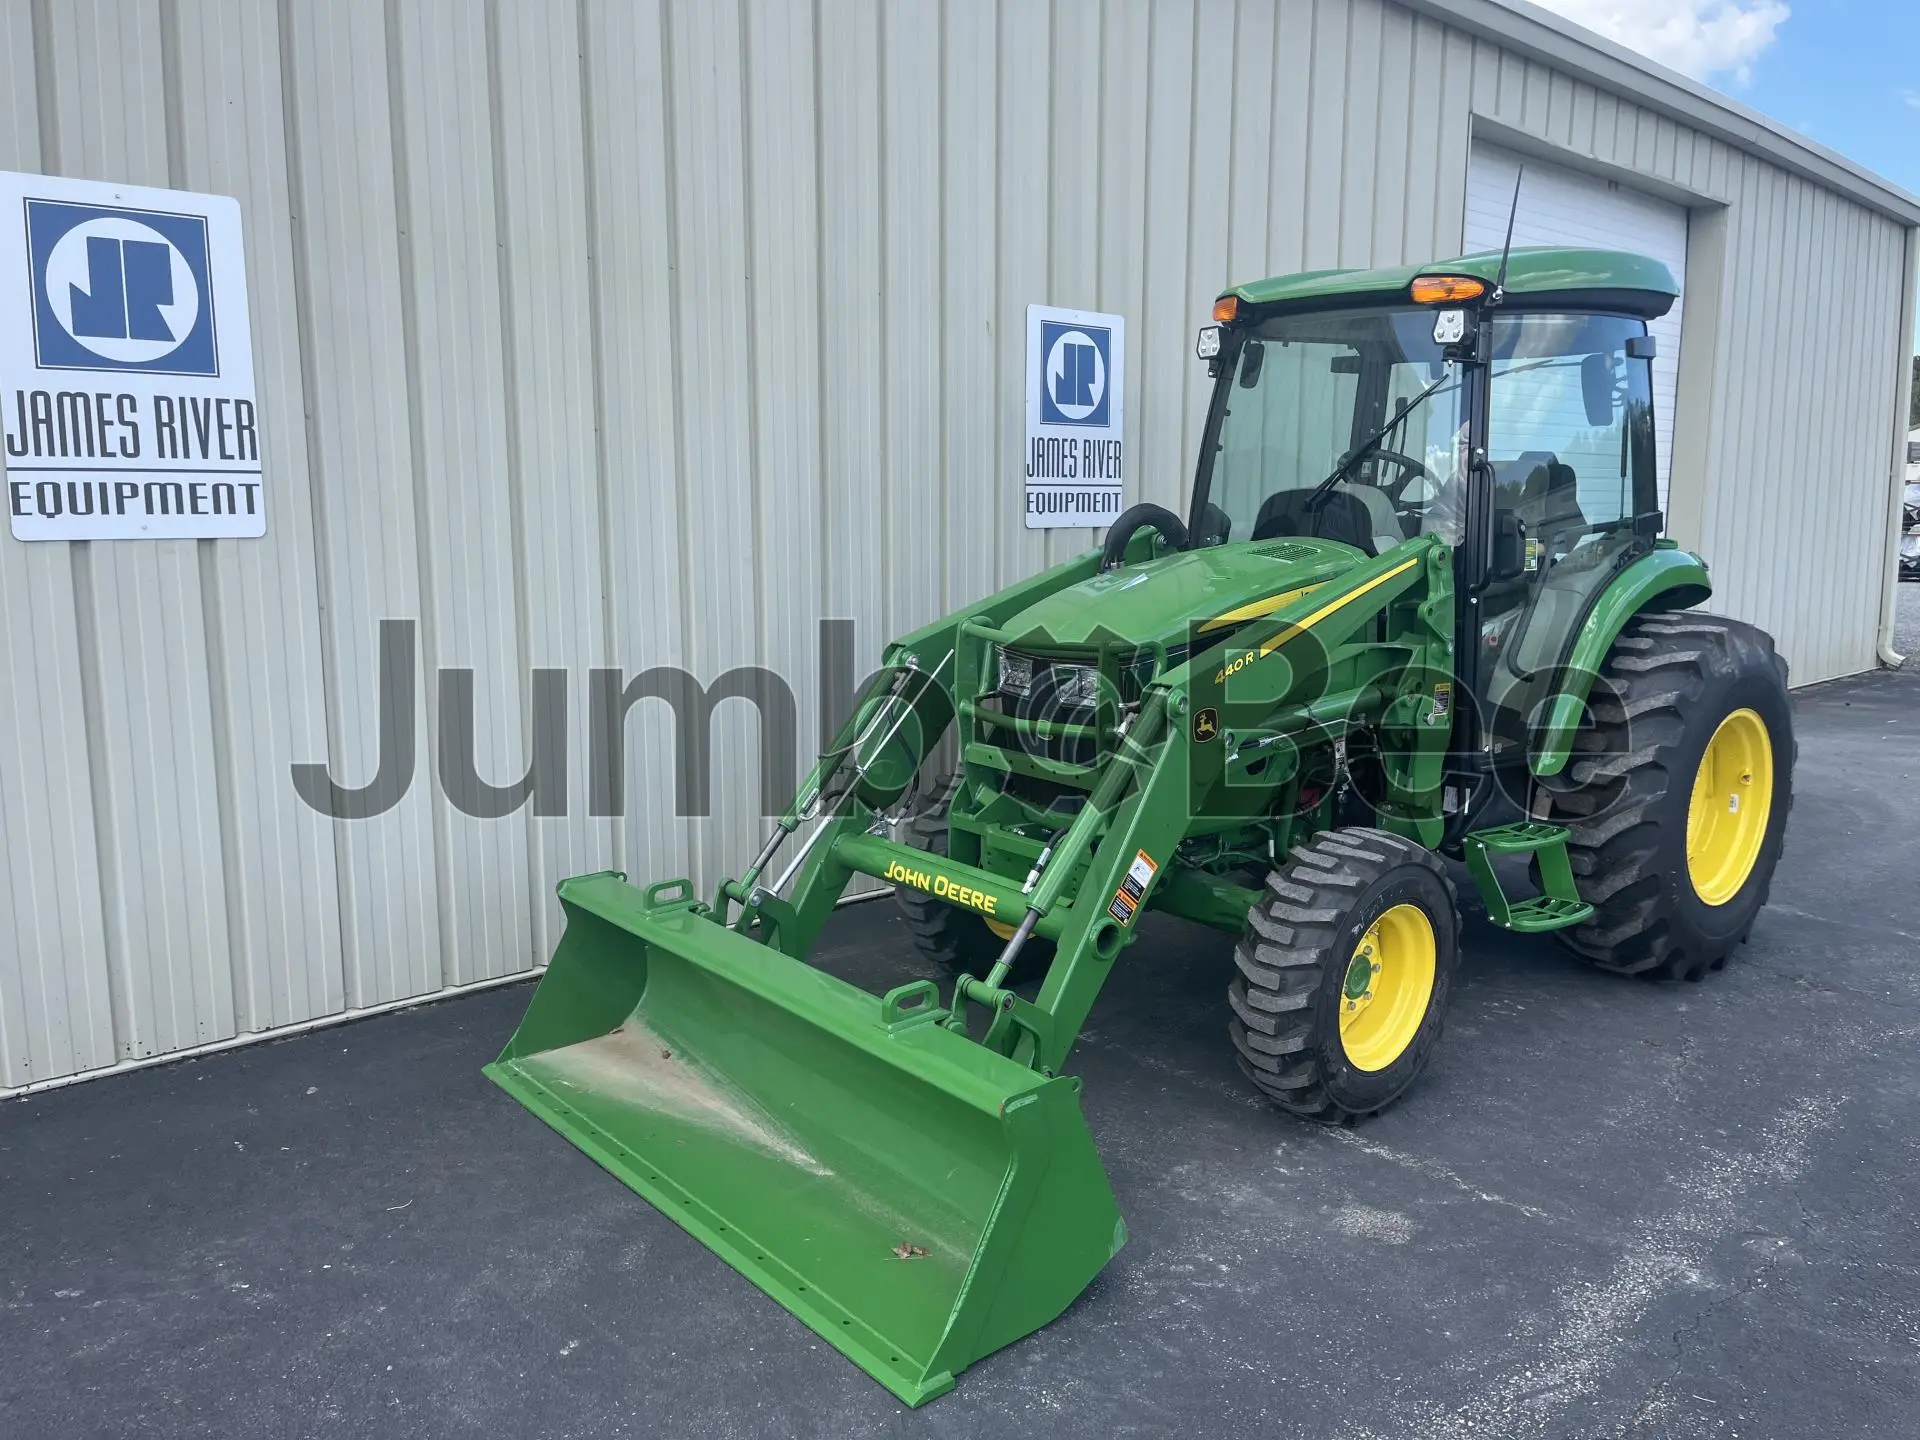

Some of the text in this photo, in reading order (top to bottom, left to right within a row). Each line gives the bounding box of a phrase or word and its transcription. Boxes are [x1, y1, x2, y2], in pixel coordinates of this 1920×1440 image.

[7, 389, 258, 461] JAMES RIVER
[1027, 437, 1122, 479] JAMES RIVER
[10, 482, 260, 518] EQUIPMENT
[1027, 492, 1121, 515] EQUIPMENT
[884, 860, 998, 915] JOHN DEERE
